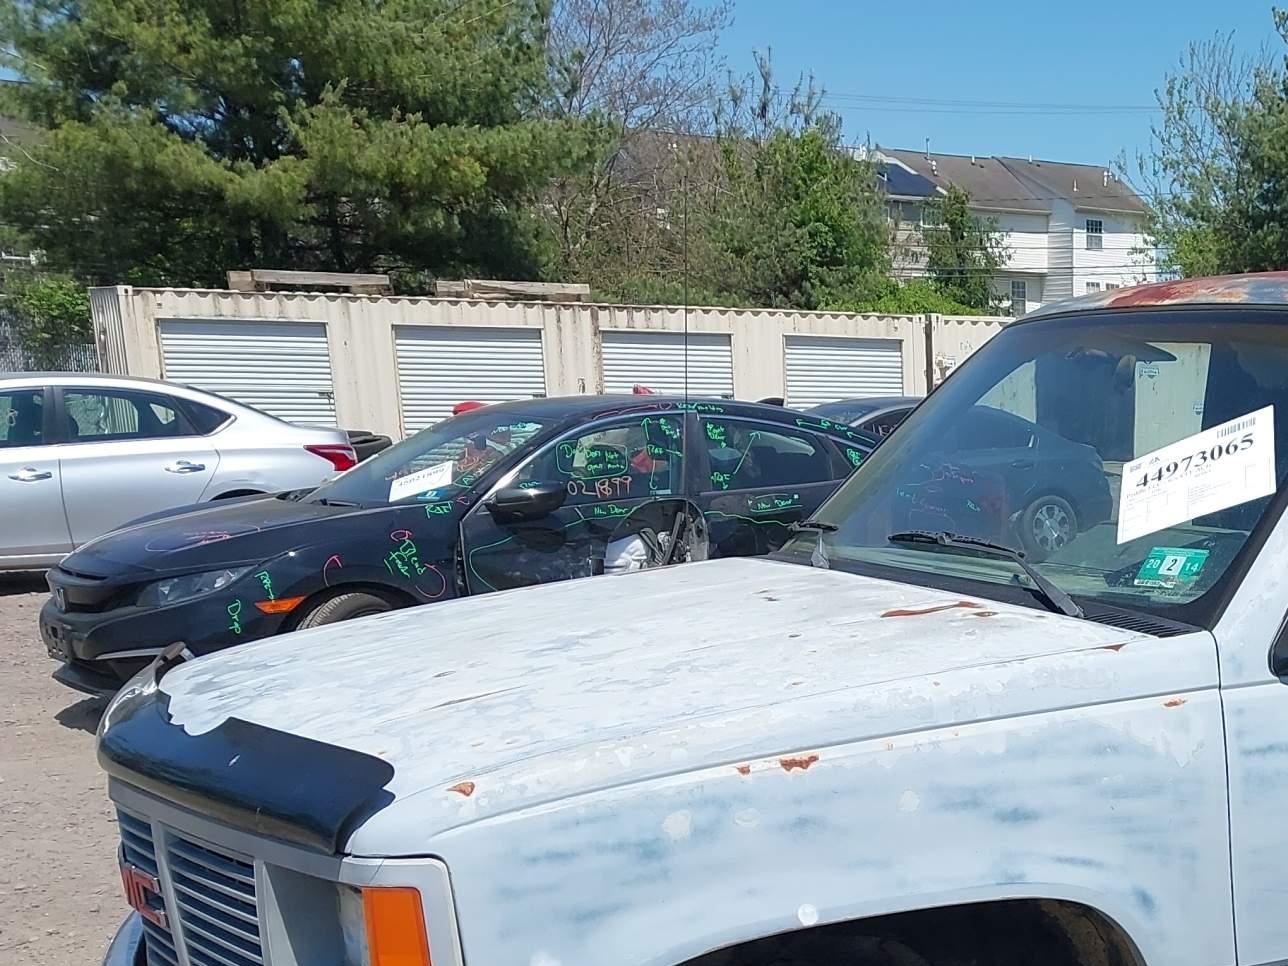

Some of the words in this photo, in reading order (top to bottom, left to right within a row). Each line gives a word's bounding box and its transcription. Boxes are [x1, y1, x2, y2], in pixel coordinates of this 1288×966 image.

[1136, 433, 1254, 488] 44973065
[567, 476, 632, 498] 021899
[1146, 559, 1161, 568] 20
[1166, 558, 1178, 571] 2
